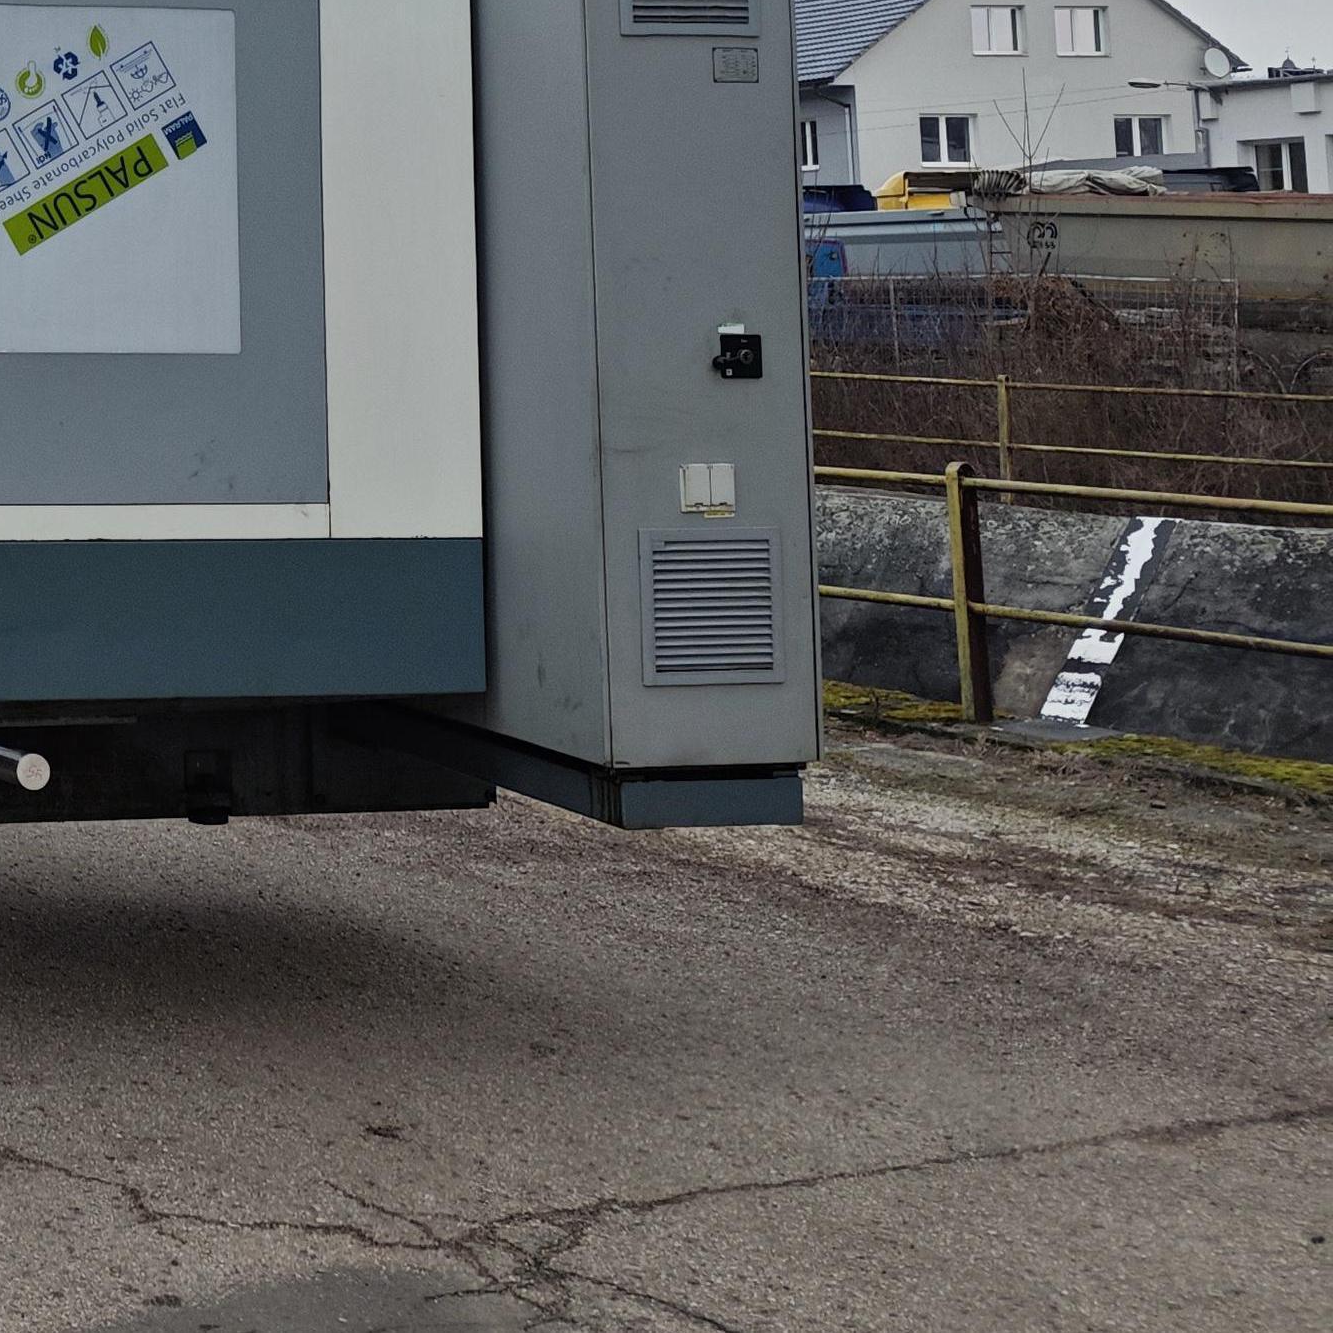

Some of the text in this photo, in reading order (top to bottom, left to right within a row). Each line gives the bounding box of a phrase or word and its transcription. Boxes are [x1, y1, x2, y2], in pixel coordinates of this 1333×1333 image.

[162, 92, 187, 114] Flat
[129, 110, 160, 138] Solid
[164, 113, 194, 135] PALRAM
[33, 134, 126, 190] Polycarbonate
[27, 145, 154, 240] PALSUN
